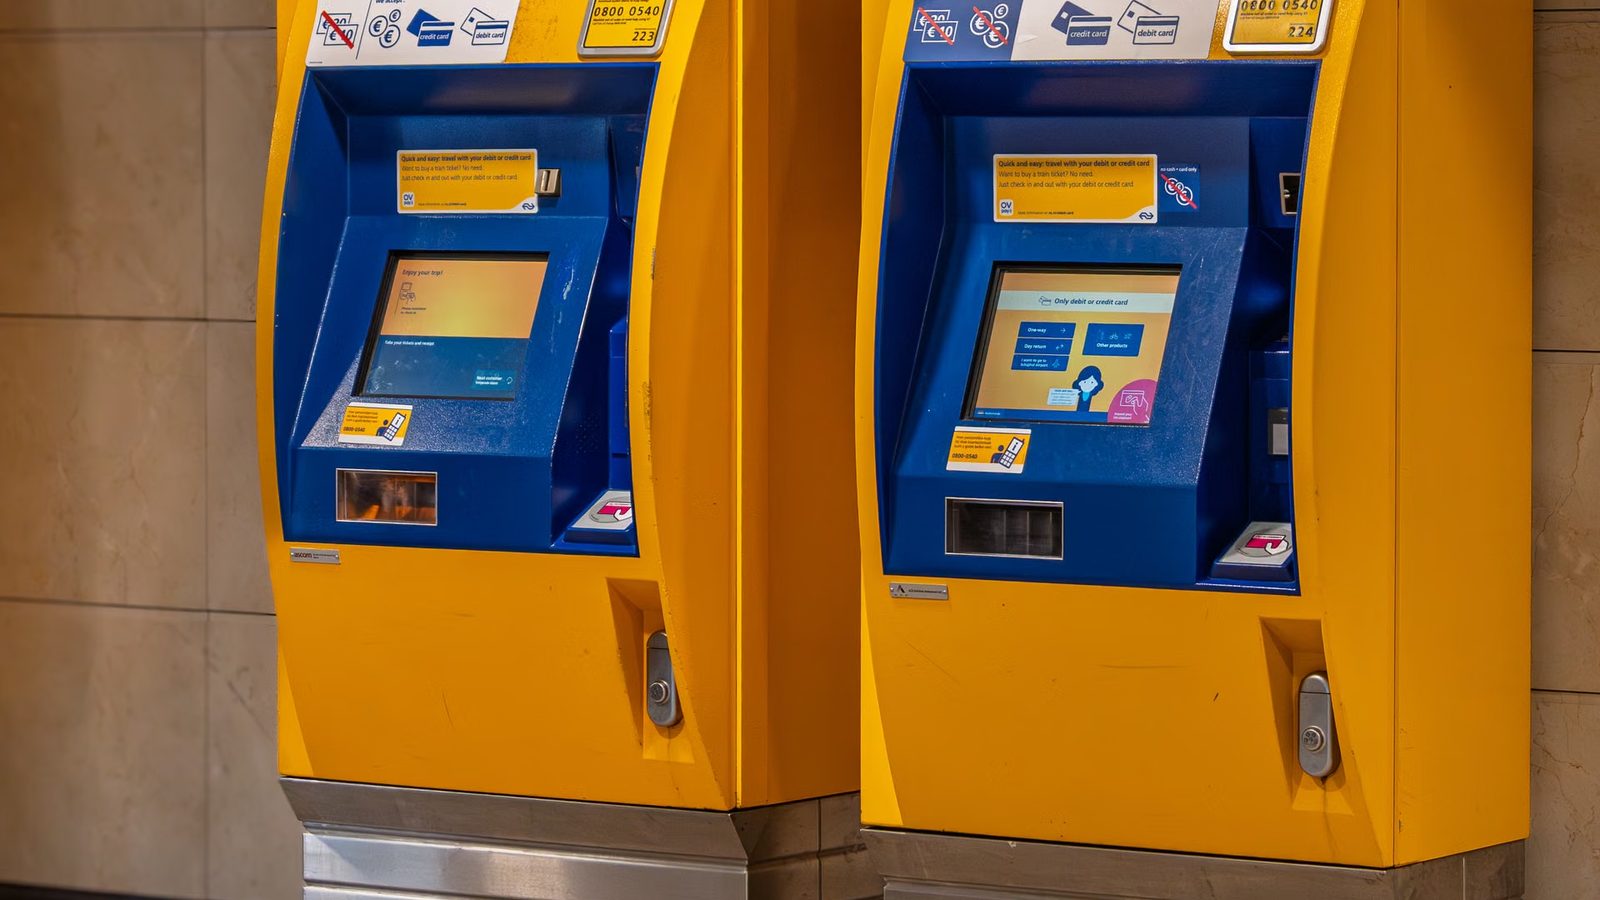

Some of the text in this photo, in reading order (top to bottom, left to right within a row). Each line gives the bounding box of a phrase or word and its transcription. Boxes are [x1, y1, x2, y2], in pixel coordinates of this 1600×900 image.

[1241, 0, 1318, 10] 0800 0540
[594, 6, 660, 16] 0800 0540
[632, 31, 654, 41] 223
[1158, 29, 1174, 37] card
[1288, 27, 1313, 37] 224
